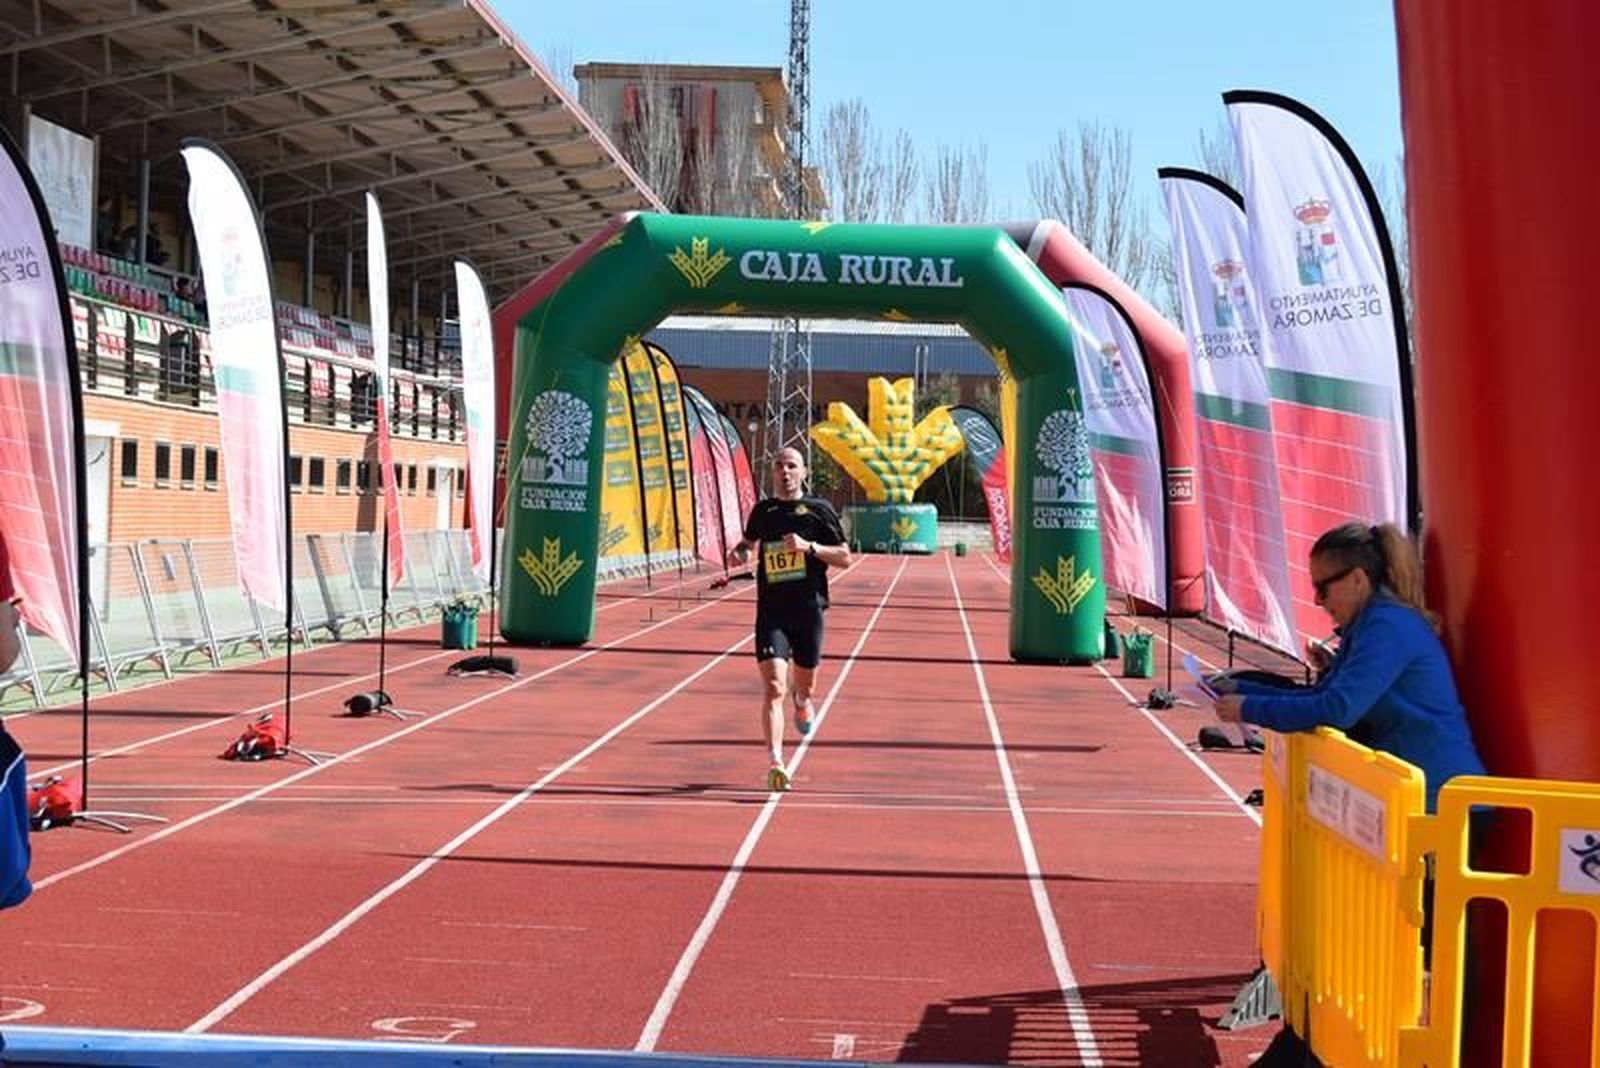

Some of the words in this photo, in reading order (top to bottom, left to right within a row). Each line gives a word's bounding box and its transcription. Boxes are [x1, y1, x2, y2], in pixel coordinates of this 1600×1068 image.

[739, 250, 828, 283] CAJA
[838, 253, 964, 287] RURAL
[769, 551, 798, 571] 167
